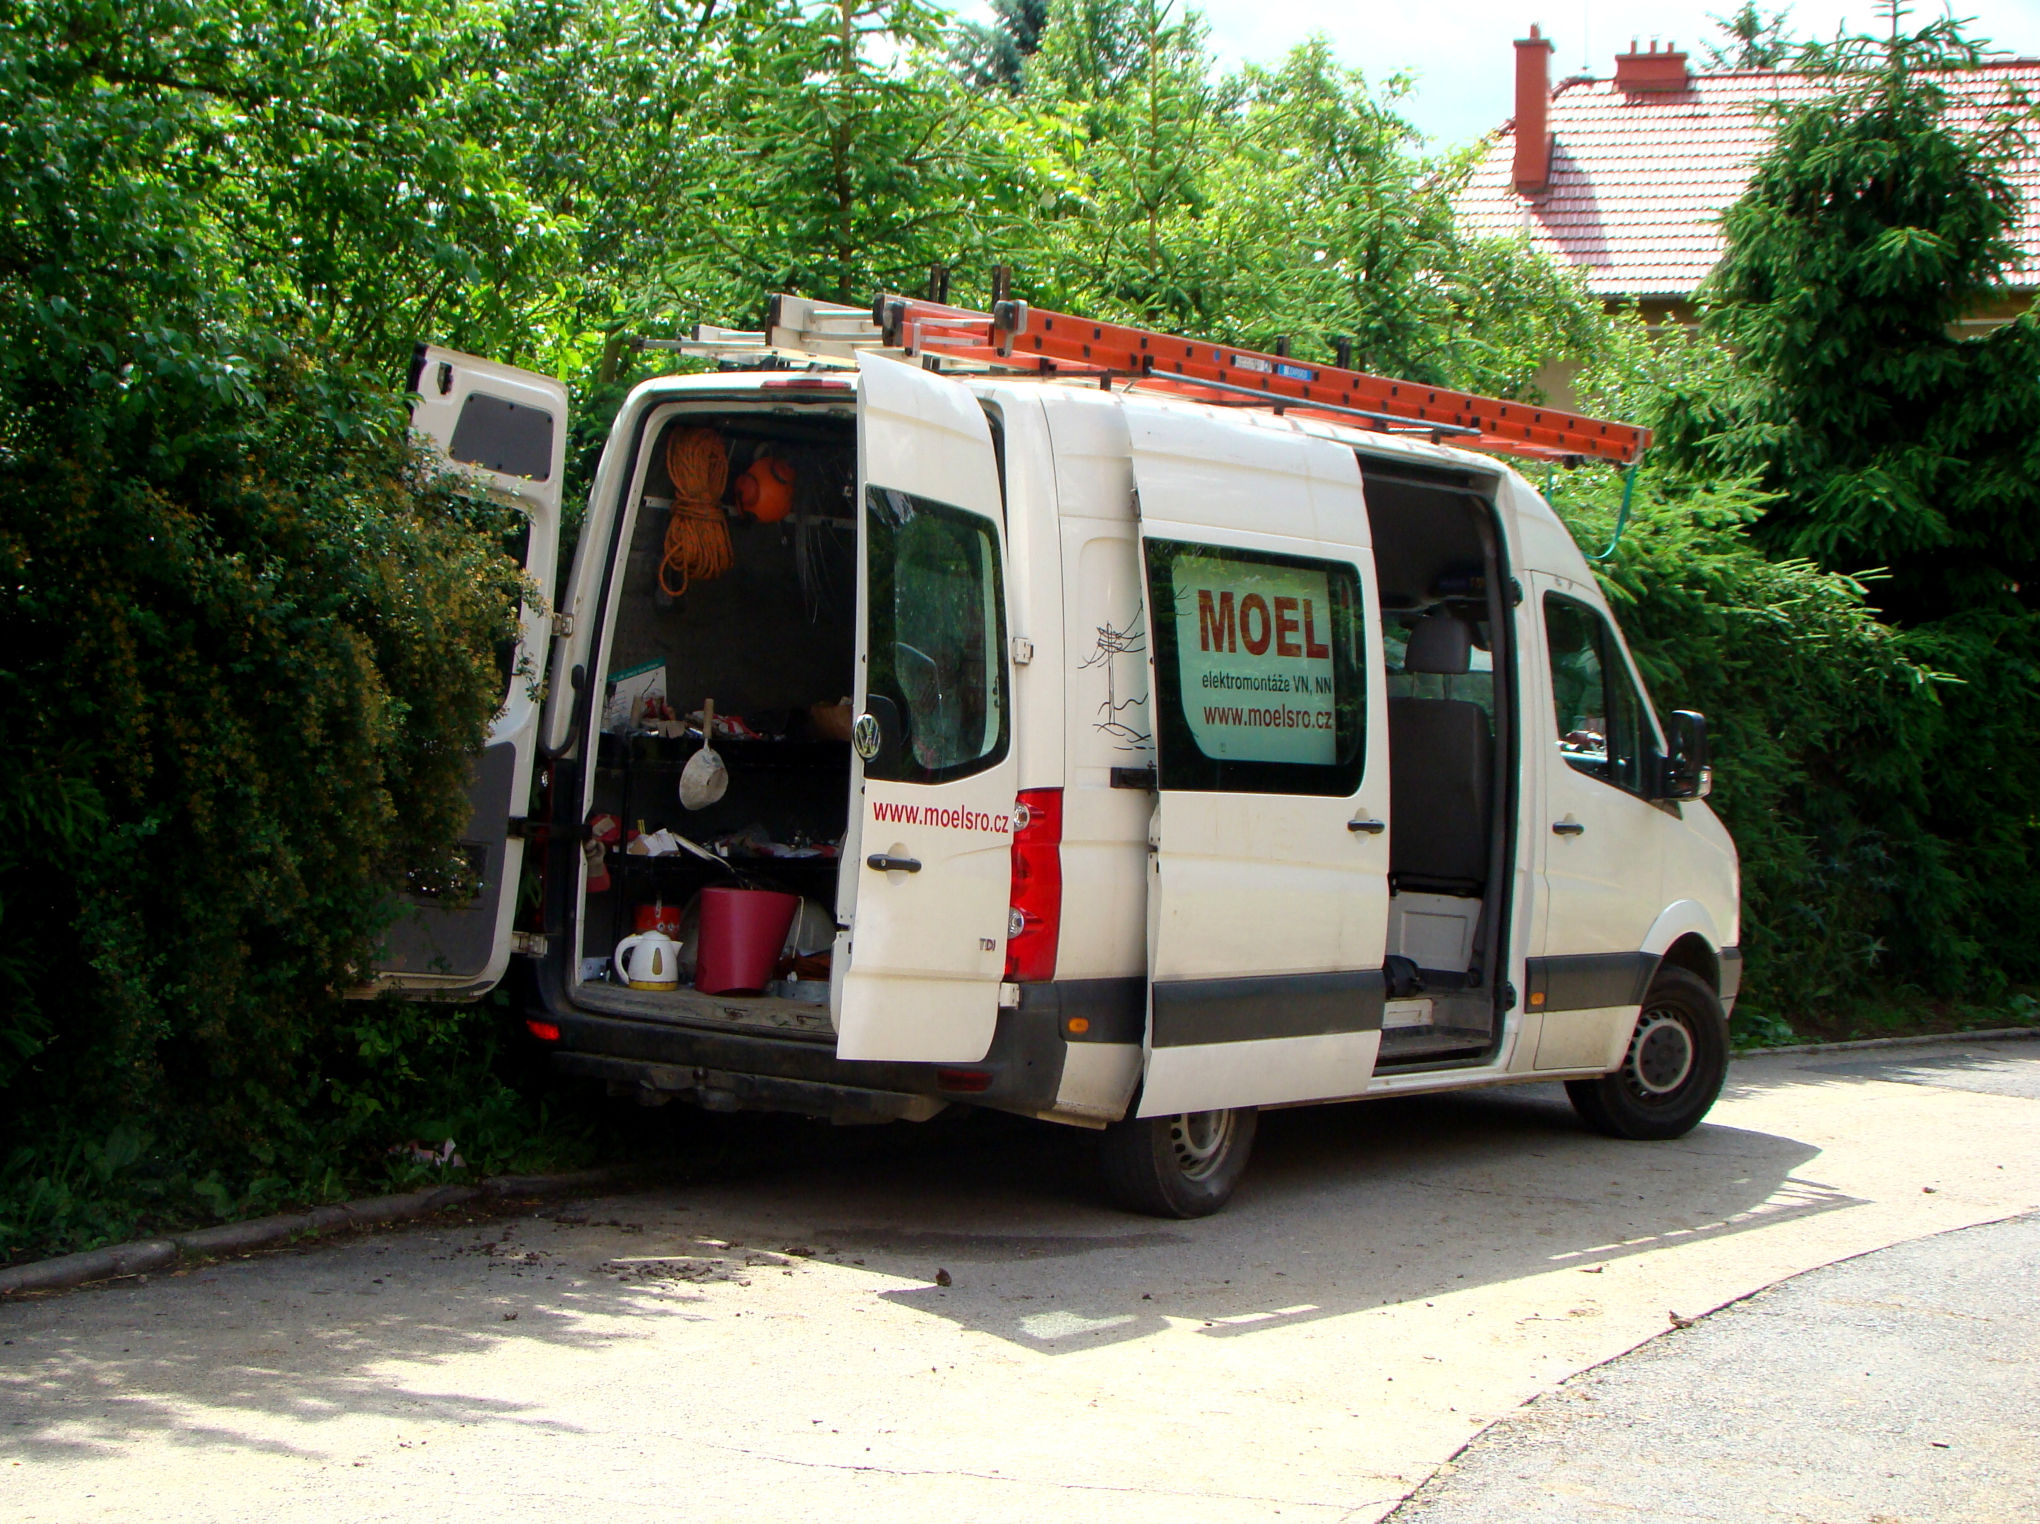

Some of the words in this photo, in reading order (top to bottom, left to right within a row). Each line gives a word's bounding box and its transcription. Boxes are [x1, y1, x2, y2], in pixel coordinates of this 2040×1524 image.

[1197, 589, 1330, 659] MOEL
[1202, 671, 1290, 692] elektromontáže
[1293, 675, 1313, 696] VN,
[1316, 676, 1332, 694] NN
[1203, 704, 1333, 729] www.moelsro.cz
[873, 802, 1009, 834] www.moelsro.cz
[979, 938, 996, 952] TDI
